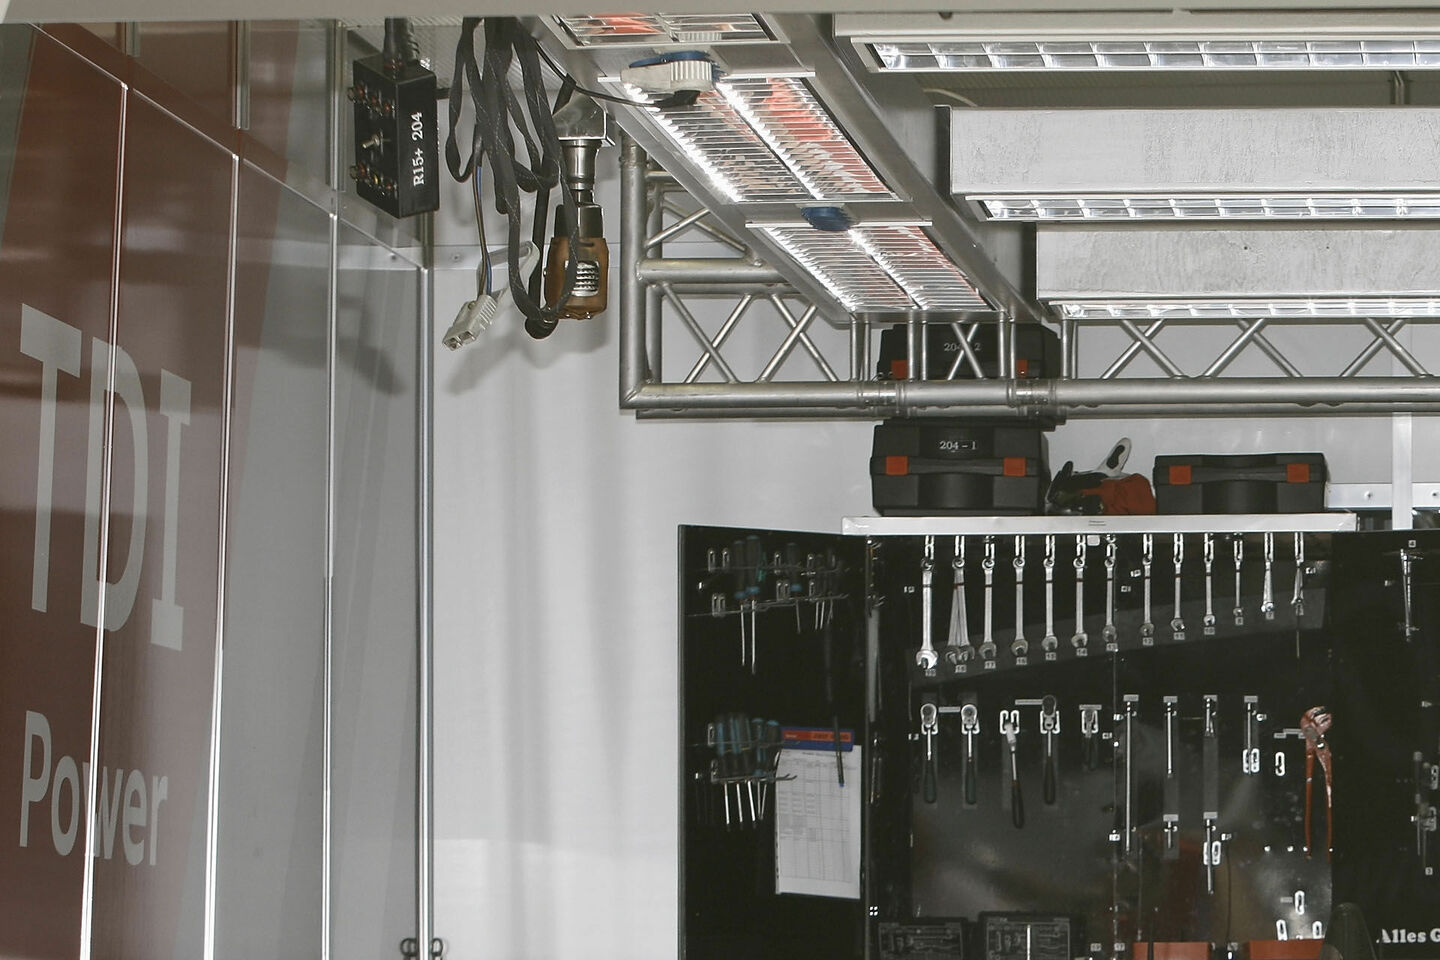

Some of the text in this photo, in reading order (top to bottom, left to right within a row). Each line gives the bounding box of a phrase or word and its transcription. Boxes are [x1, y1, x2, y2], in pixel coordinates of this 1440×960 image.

[411, 111, 426, 187] R15+ 204
[20, 303, 192, 652] TDI
[939, 440, 959, 450] 204
[19, 710, 169, 867] Power
